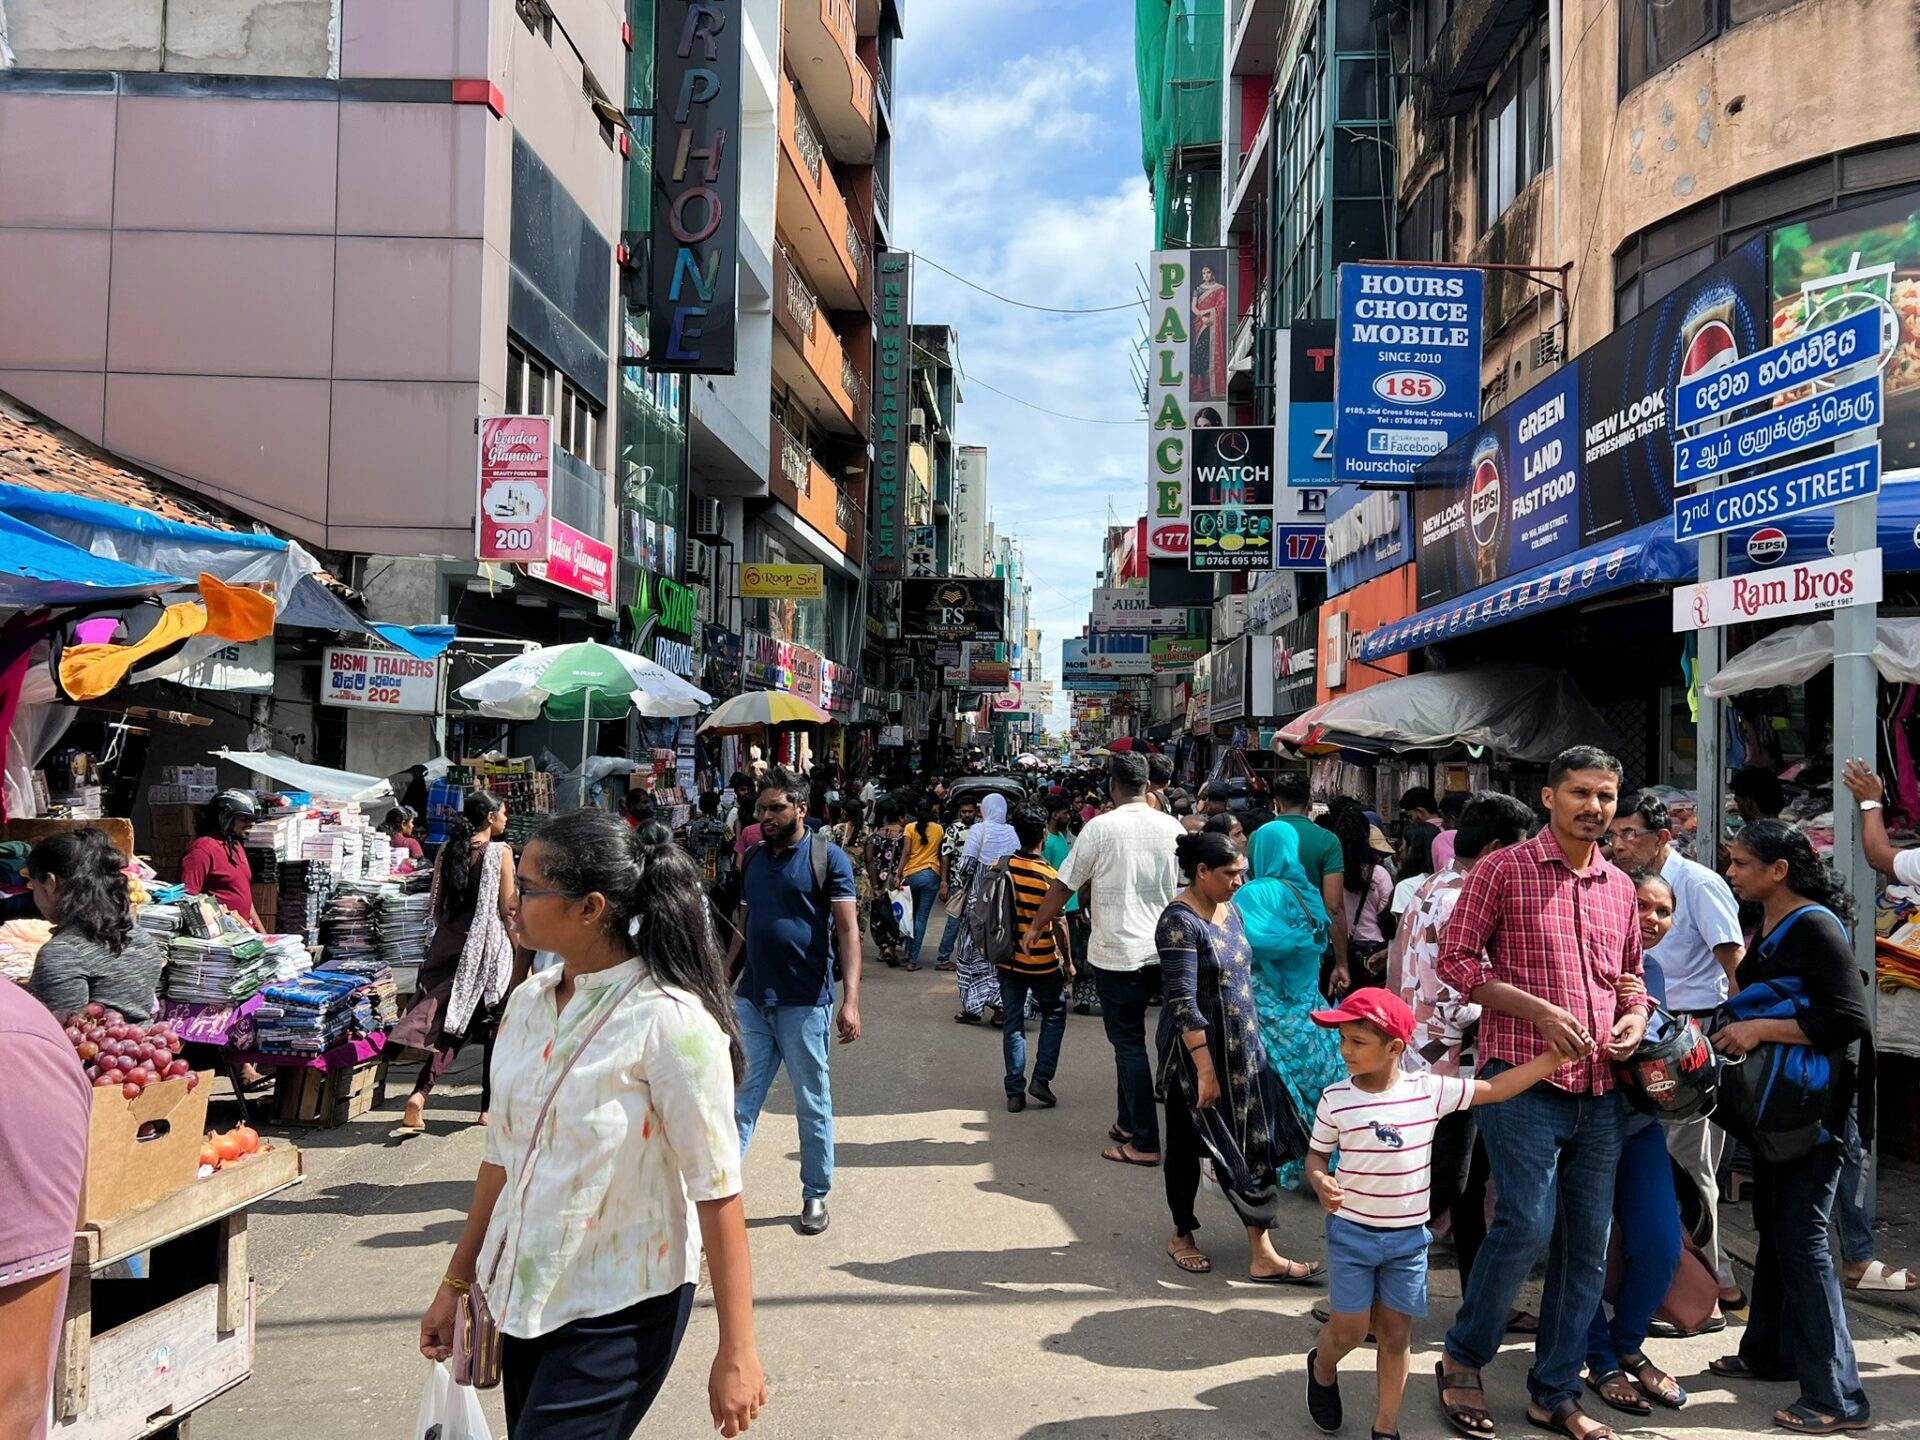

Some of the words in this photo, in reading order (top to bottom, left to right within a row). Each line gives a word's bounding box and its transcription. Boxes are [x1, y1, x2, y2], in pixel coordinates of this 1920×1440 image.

[1360, 275, 1464, 298] HOURS
[881, 282, 901, 328] NEW
[1355, 299, 1468, 322] CHOICE
[1352, 324, 1469, 347] MOBILE
[1378, 351, 1411, 362] SINCE
[1414, 353, 1442, 364] 2010
[880, 335, 899, 442] MOULANA
[1154, 263, 1188, 518] PALACE
[1386, 378, 1432, 397] 185
[1404, 409, 1429, 417] Street,
[1518, 392, 1565, 444] GREEN
[1585, 413, 1618, 448] NEW
[1619, 387, 1665, 430] LOOK
[493, 430, 538, 446] London
[1585, 427, 1635, 464] REFRESHING
[1636, 411, 1665, 438] TASTE
[1680, 448, 1690, 471] 2
[1696, 433, 1731, 470] ஆம்
[1738, 390, 1875, 458] குறுக்குத்தெரு
[488, 446, 542, 467] Glamour
[1391, 441, 1444, 453] Facebook
[1523, 439, 1562, 482] LAND
[1197, 466, 1269, 482] WATCH
[878, 450, 897, 559] COMPLEX
[1209, 487, 1255, 503] LINE
[1473, 489, 1498, 517] PEPSI
[1512, 487, 1542, 520] FAST
[1542, 470, 1576, 507] FOOD
[1682, 498, 1709, 533] 2nd
[1716, 485, 1779, 524] CROSS
[1786, 459, 1871, 507] STREET
[1422, 512, 1441, 535] NEW
[1441, 499, 1465, 526] LOOK
[1450, 516, 1465, 533] TASTE
[495, 528, 532, 550] 200
[1750, 541, 1785, 551] PEPSI
[1206, 557, 1230, 565] 0766
[1232, 557, 1249, 565] 695
[1251, 557, 1269, 565] 996
[762, 573, 792, 586] Roop
[797, 574, 816, 585] Sri
[1732, 577, 1788, 616] Ram
[1793, 567, 1854, 602] Bros
[659, 578, 695, 635] STAR
[1814, 600, 1836, 610] SINCE
[1837, 597, 1854, 605] 1967
[941, 607, 964, 625] FS
[330, 653, 368, 672] BISMI
[373, 657, 434, 678] TRADERS
[367, 687, 400, 704] 202
